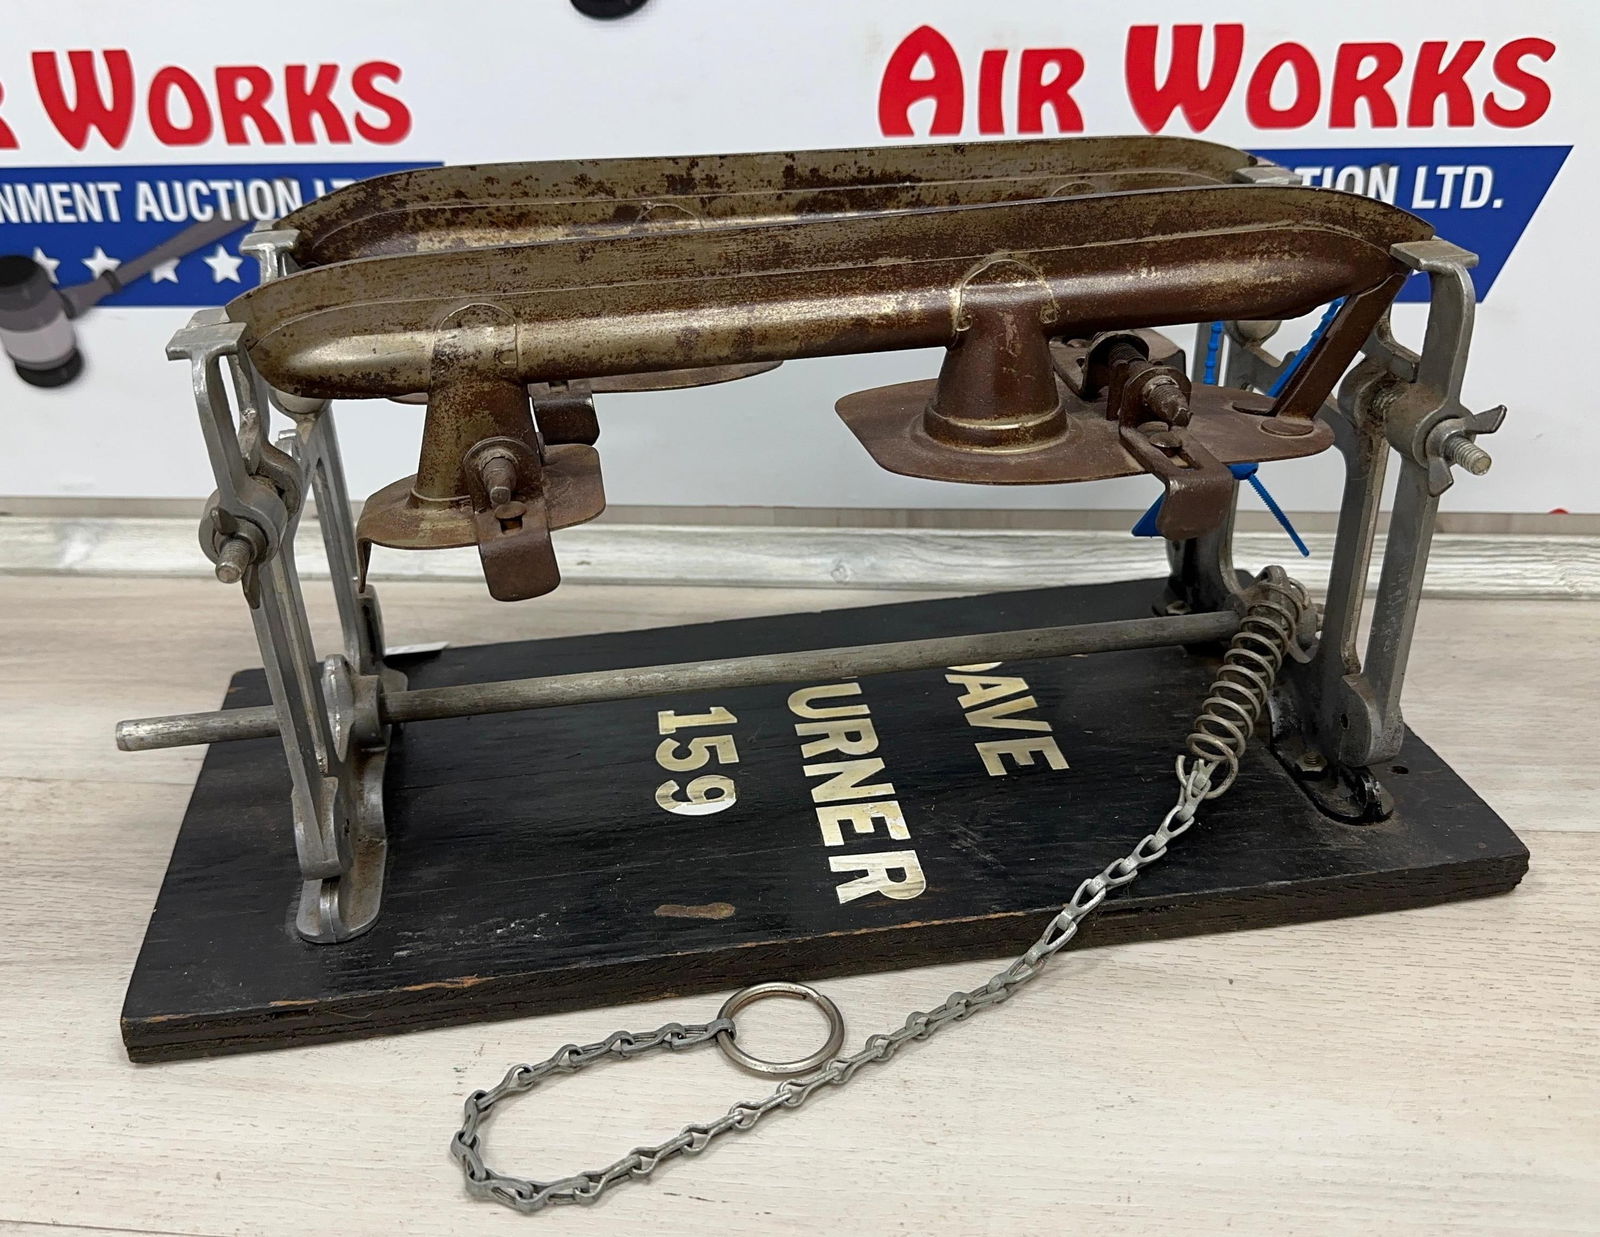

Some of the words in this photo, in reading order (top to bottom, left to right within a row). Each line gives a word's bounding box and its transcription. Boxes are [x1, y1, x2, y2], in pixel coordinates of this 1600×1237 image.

[31, 49, 413, 151] WORKS
[878, 25, 1085, 137] AIR
[1125, 24, 1557, 134] WORKS
[136, 179, 303, 222] AUCTION
[1411, 165, 1504, 209] LTD.
[655, 706, 739, 816] 159
[945, 661, 1070, 776] AVE
[787, 675, 927, 904] URNER
